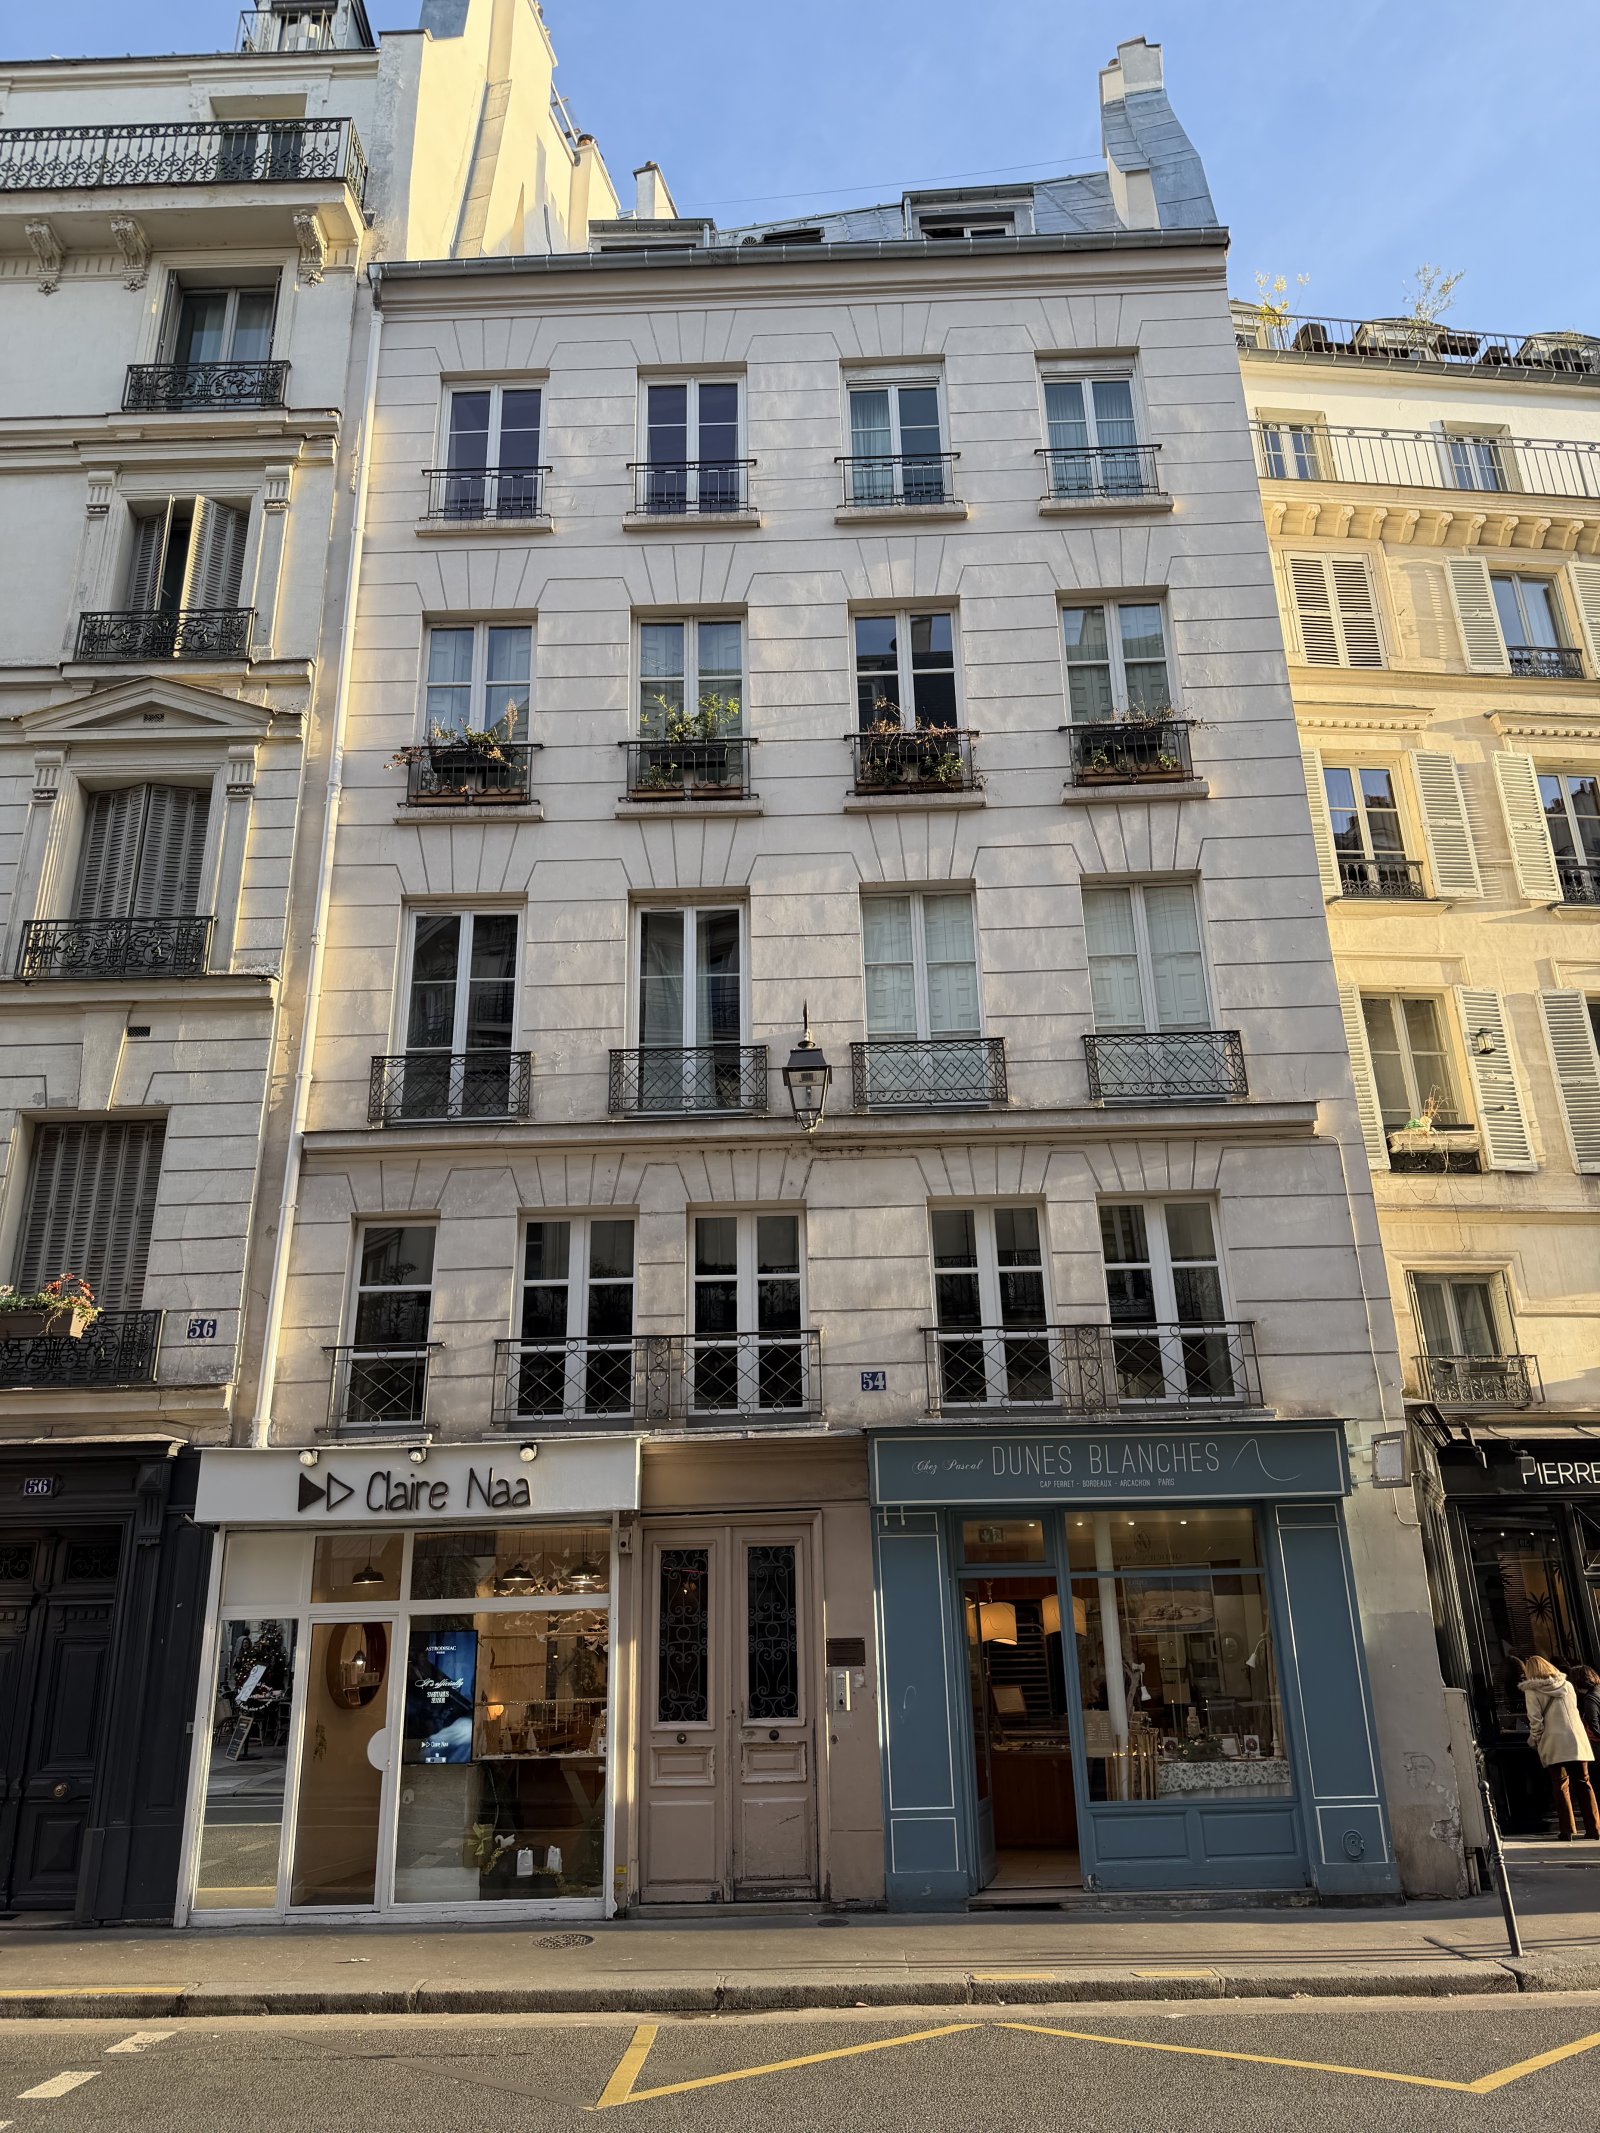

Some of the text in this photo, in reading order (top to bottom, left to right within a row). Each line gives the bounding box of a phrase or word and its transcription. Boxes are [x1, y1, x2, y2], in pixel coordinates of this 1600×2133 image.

[189, 1319, 215, 1337] 56
[862, 1372, 885, 1390] 54
[912, 1458, 984, 1475] Chez Pascal
[992, 1442, 1220, 1476] DUNES BLANCHES
[28, 1479, 48, 1494] 56
[366, 1467, 532, 1511] Claire Naa
[1039, 1480, 1052, 1488] CAP
[1054, 1480, 1074, 1488] FERRET
[1082, 1479, 1112, 1488] BORDEAUX
[1120, 1479, 1151, 1487] ARCACHON
[1158, 1478, 1175, 1486] PARIS
